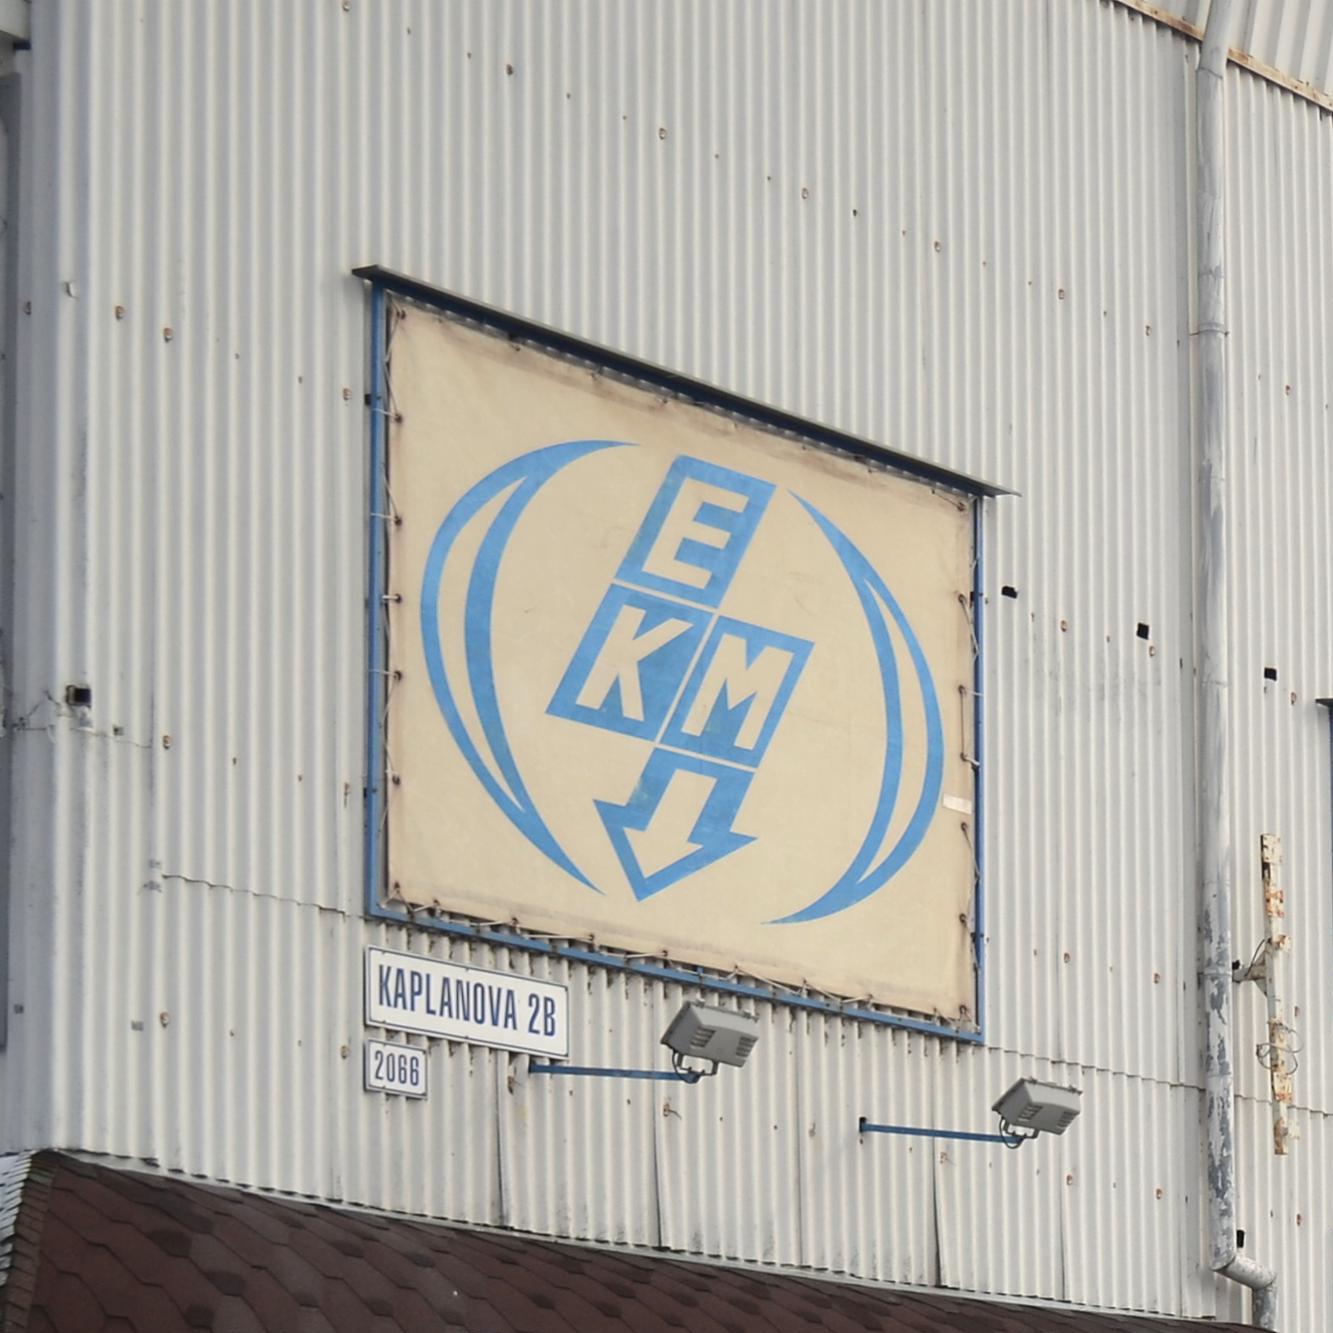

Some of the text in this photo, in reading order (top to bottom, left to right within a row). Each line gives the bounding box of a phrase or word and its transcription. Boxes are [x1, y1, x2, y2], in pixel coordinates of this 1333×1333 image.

[379, 964, 556, 1037] KAPLANOVA 2B
[374, 1051, 419, 1087] 2066
